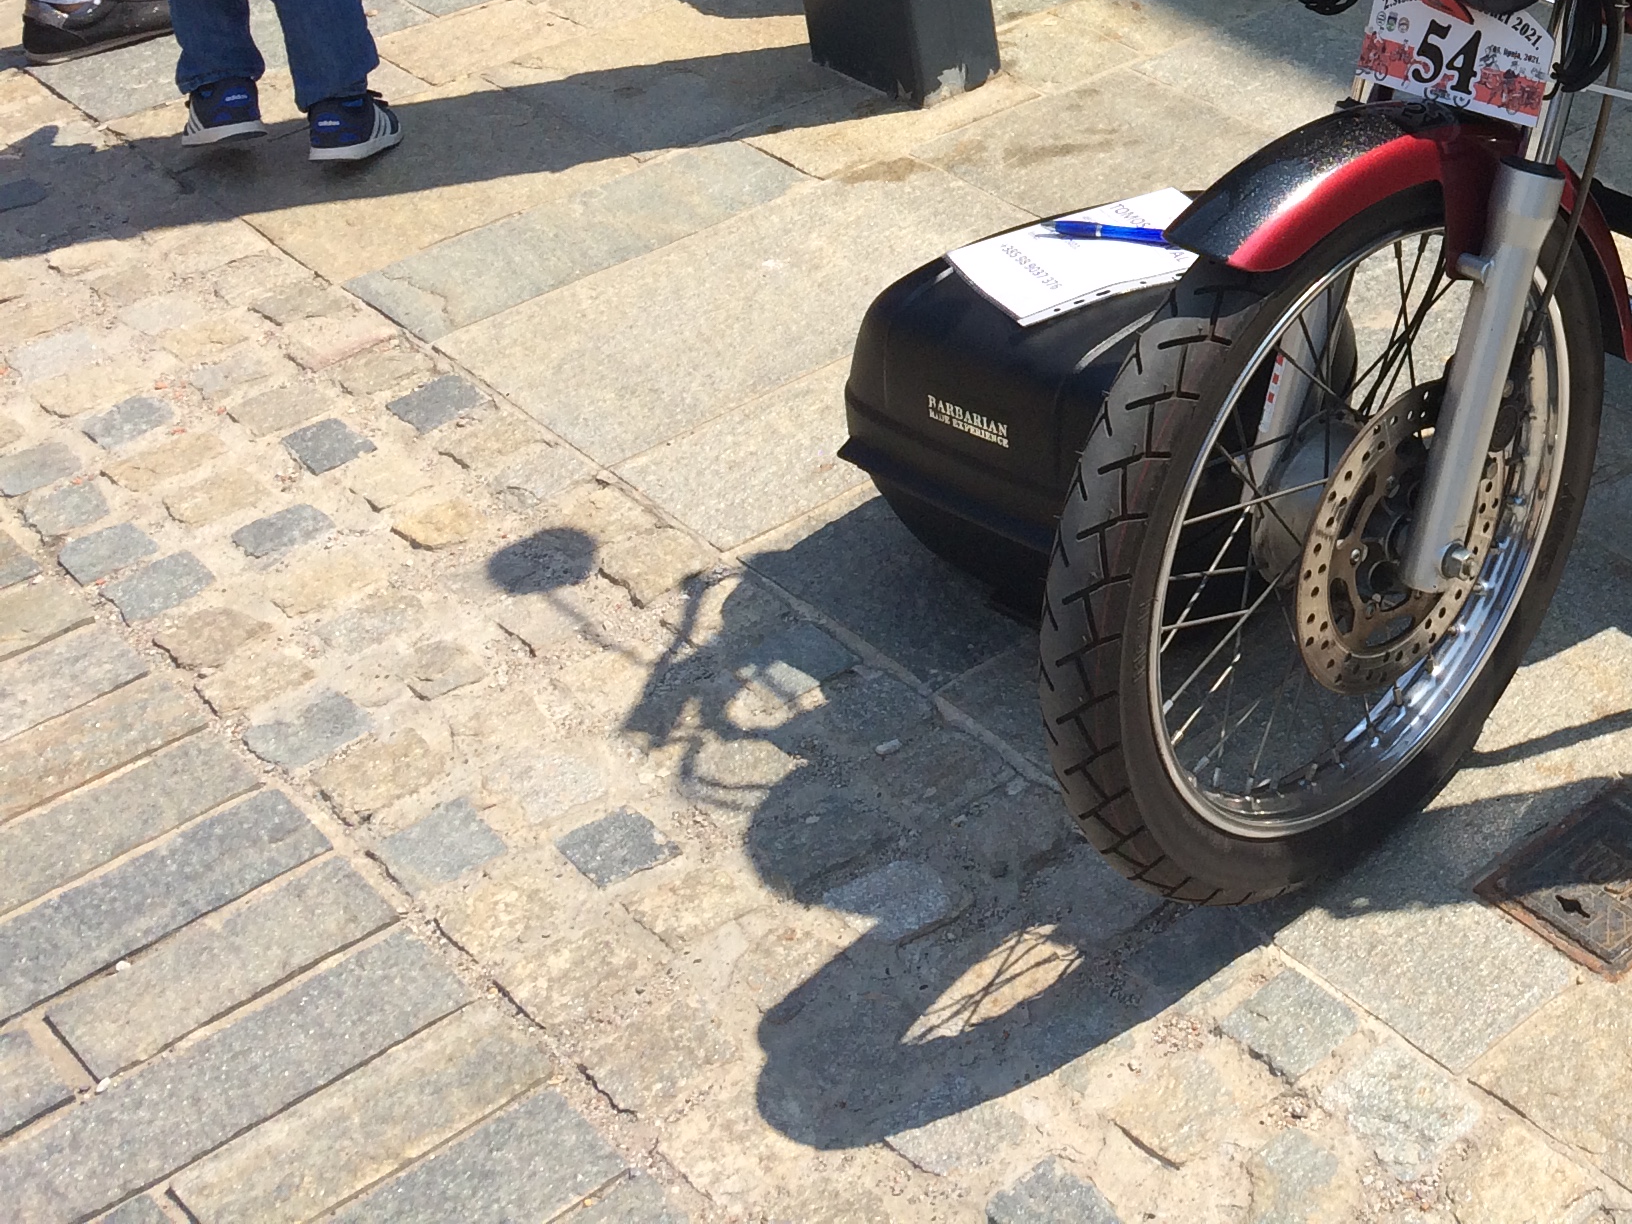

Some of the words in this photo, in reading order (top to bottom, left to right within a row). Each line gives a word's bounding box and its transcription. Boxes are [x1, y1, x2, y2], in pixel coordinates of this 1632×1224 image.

[1511, 16, 1543, 51] 2021.
[1411, 19, 1482, 96] 54
[318, 119, 340, 127] adidas
[1110, 203, 1151, 229] TOMOS
[927, 394, 1008, 437] BARBARIAN
[952, 417, 1010, 449] EXPERIENCE
